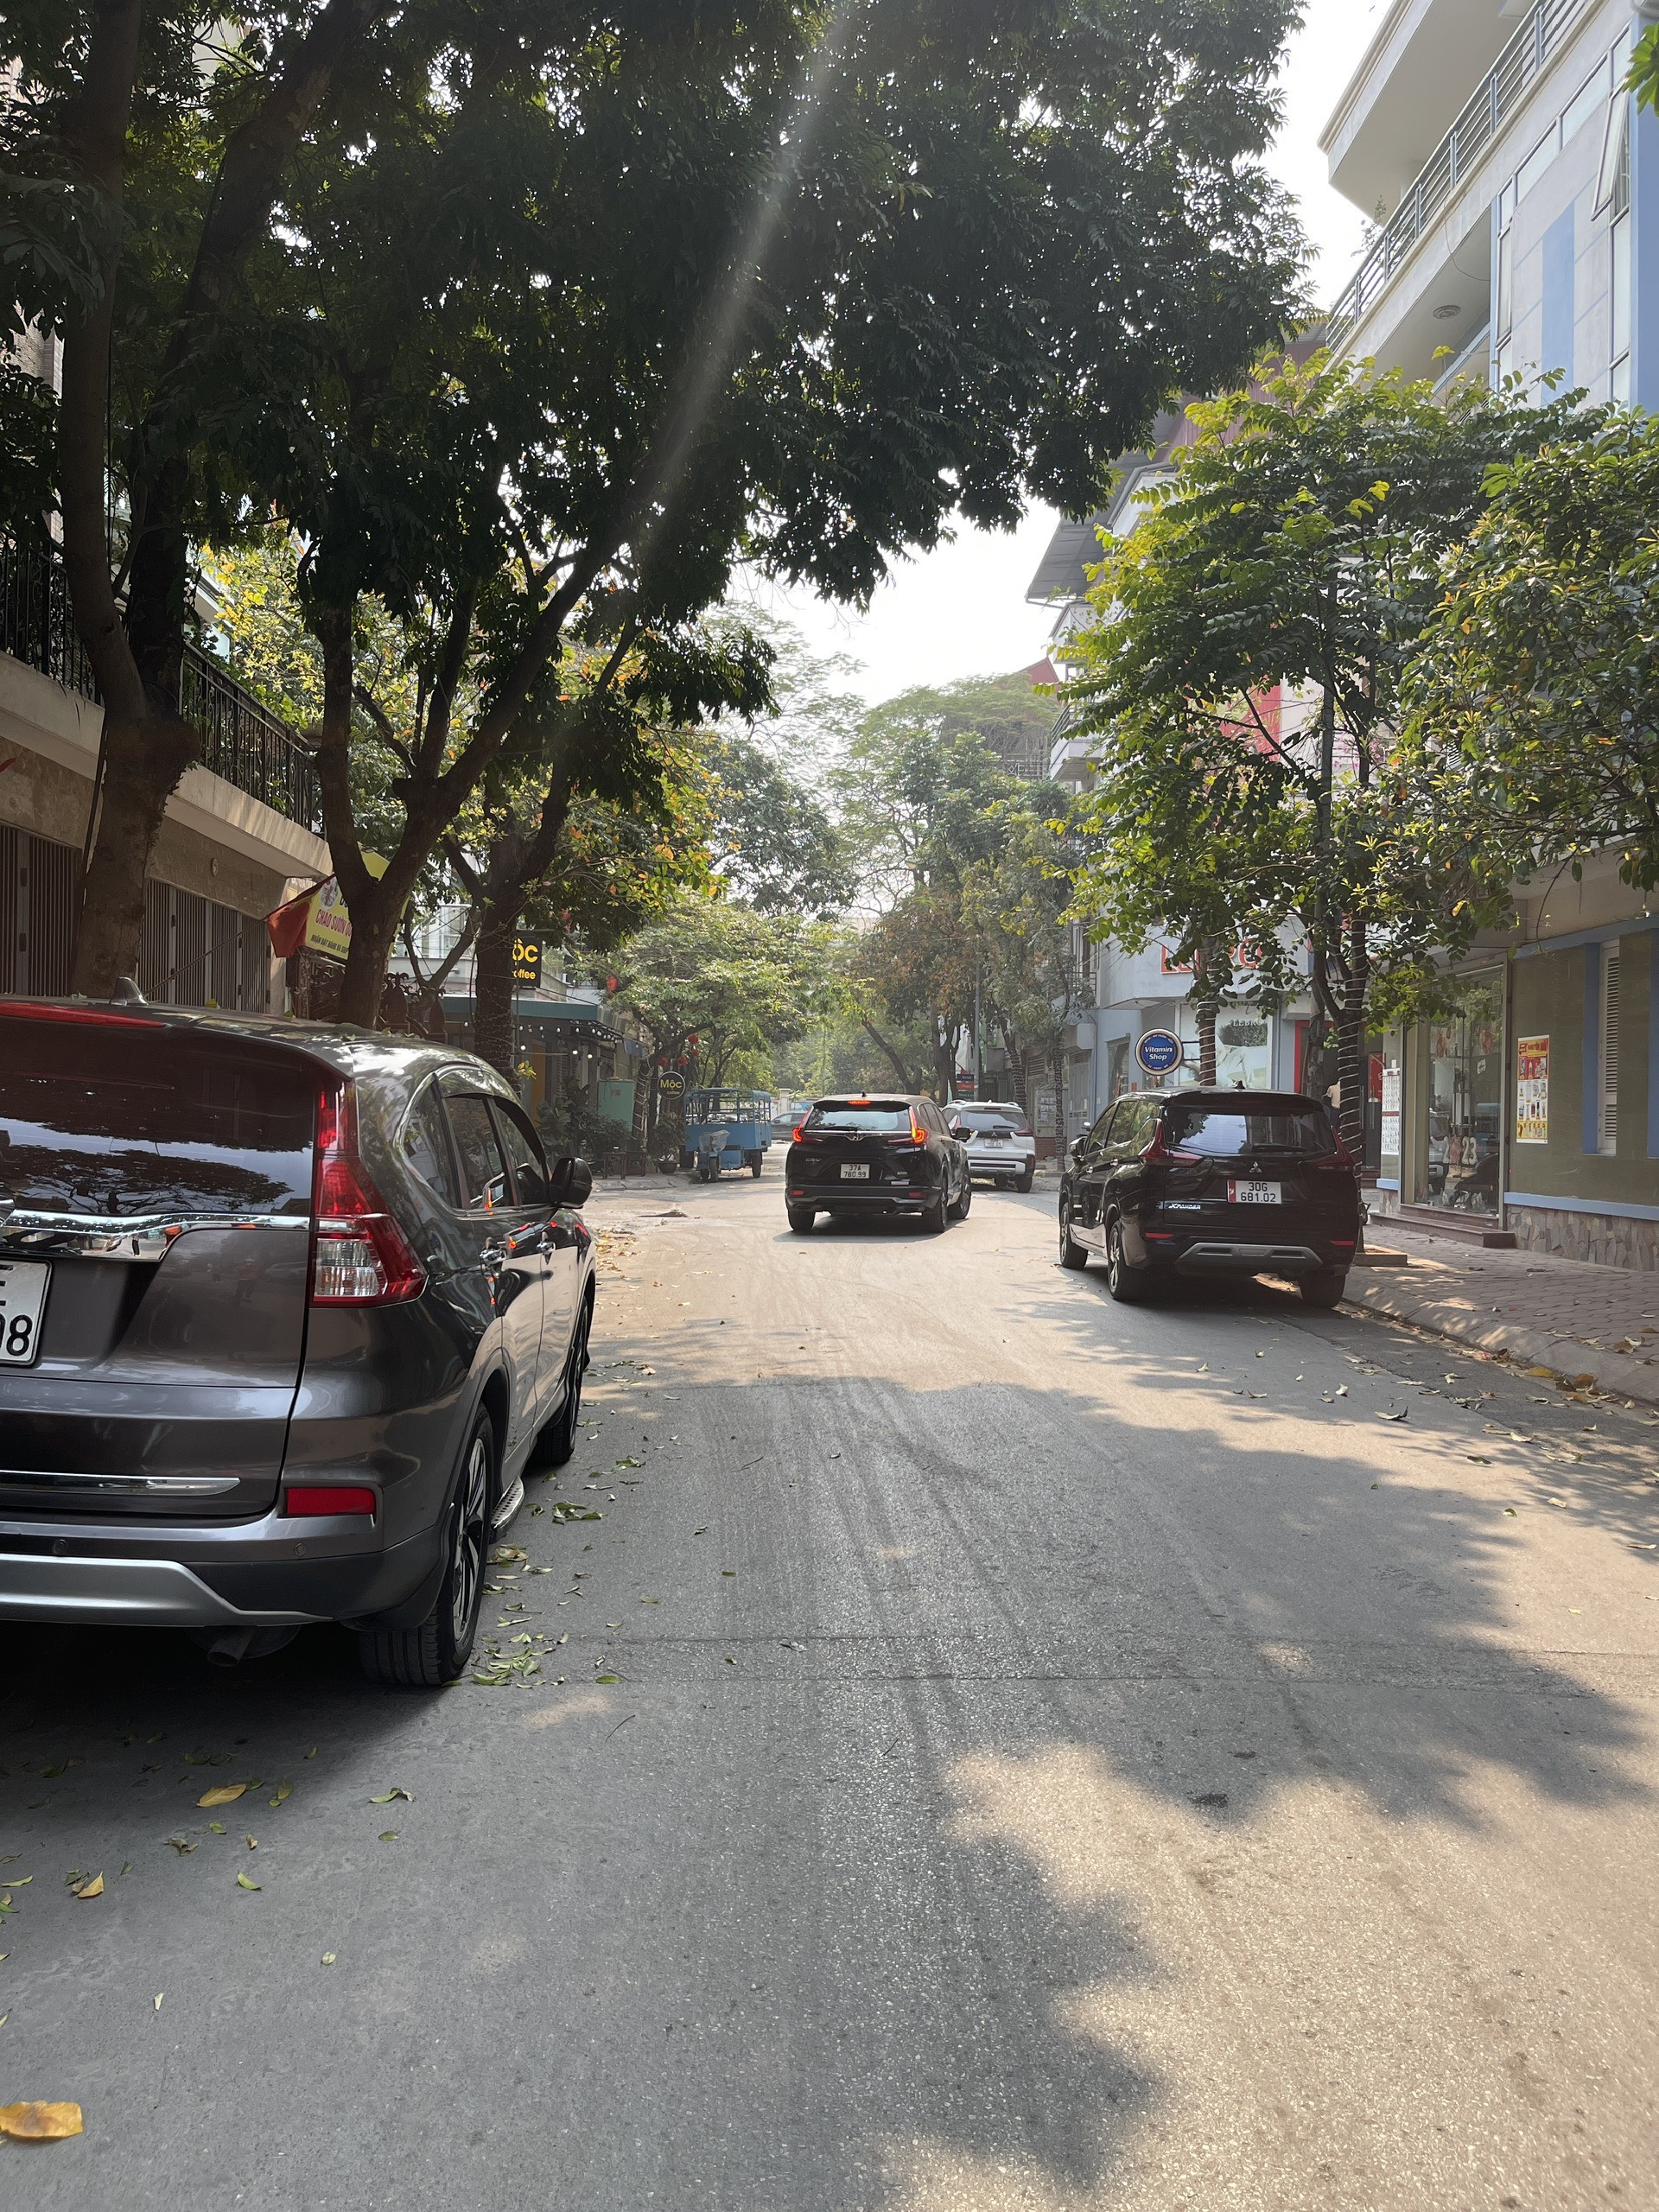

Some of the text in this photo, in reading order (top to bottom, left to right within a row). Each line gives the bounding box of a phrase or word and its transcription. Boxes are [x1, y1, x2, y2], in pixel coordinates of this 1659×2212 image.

[512, 938, 538, 965] ộc
[512, 969, 536, 980] offee
[1248, 1181, 1268, 1192] 30G
[1240, 1192, 1276, 1203] 681.02
